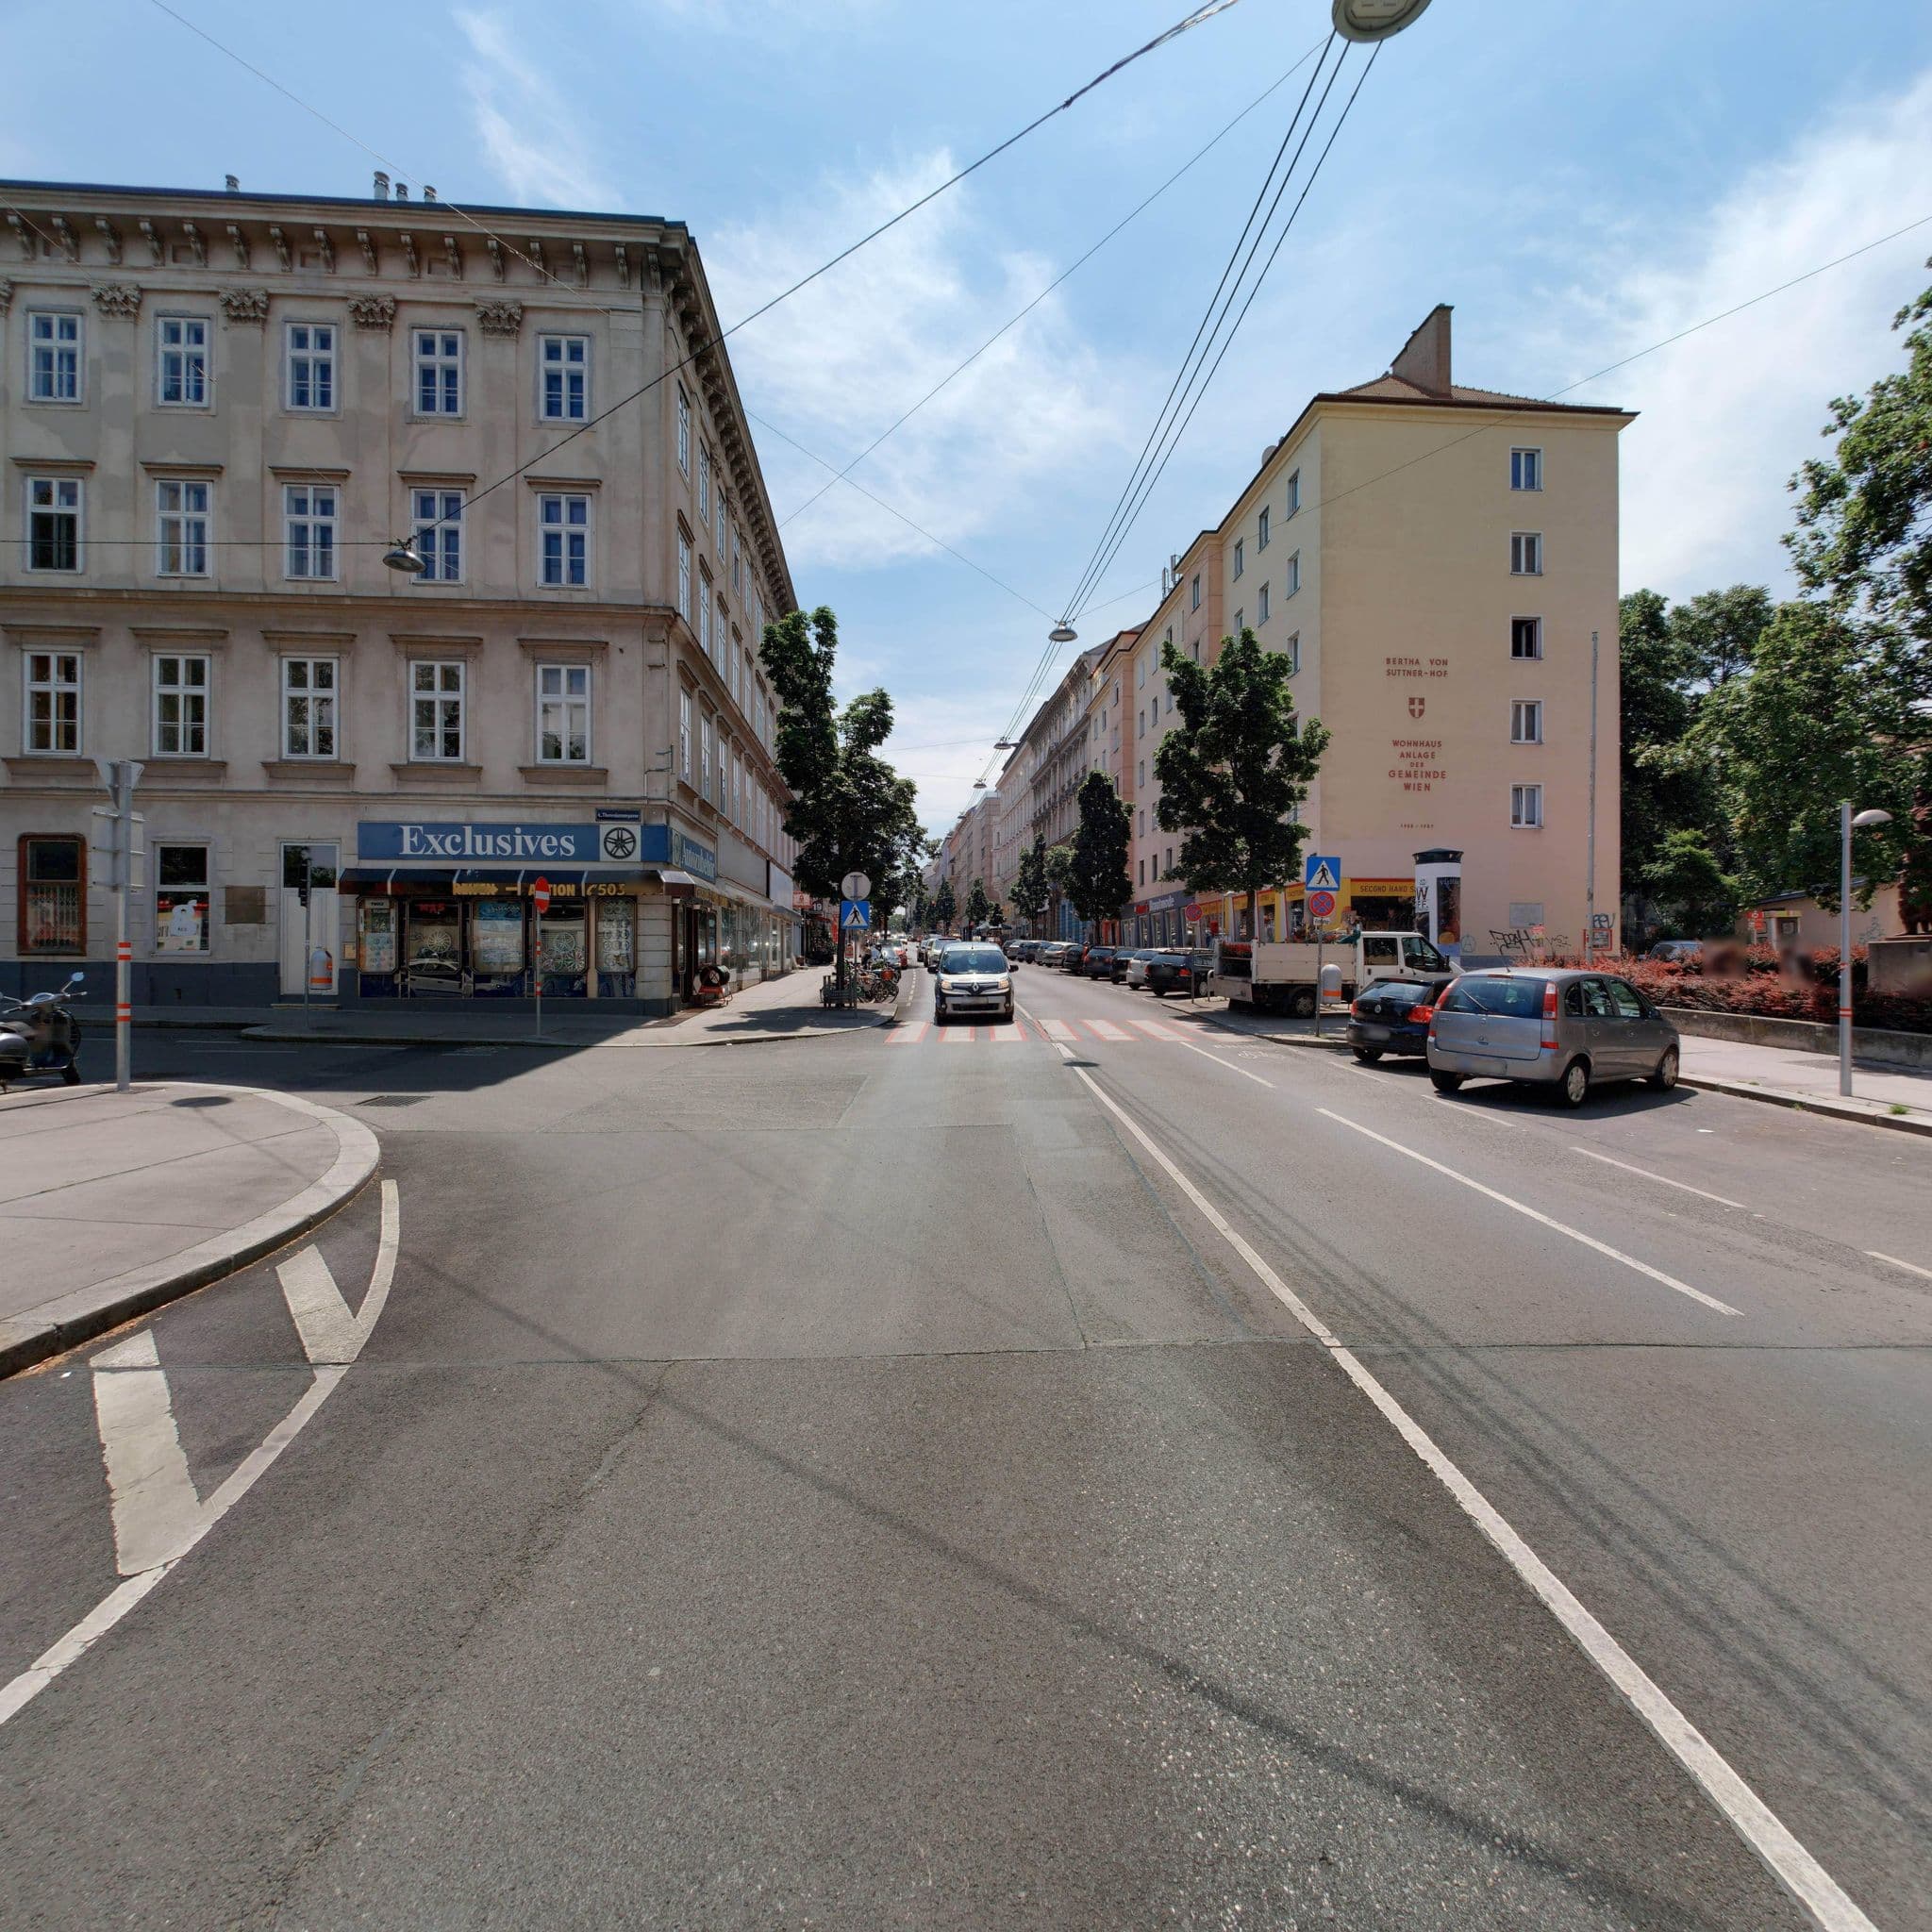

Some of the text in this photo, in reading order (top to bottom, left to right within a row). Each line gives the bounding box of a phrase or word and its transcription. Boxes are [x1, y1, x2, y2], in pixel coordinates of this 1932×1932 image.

[1386, 658, 1420, 666] BERTHA
[1386, 669, 1449, 677] SUTTNER-HOF
[1392, 740, 1442, 748] WOHNHAUS
[1399, 751, 1436, 759] ANLAGE
[1389, 770, 1447, 779] GEMEINDE
[1403, 782, 1431, 791] WIEN
[399, 824, 575, 858] Exclusives
[528, 883, 575, 896] ATION
[1359, 885, 1387, 893] SECOND
[1389, 885, 1407, 893] HAND
